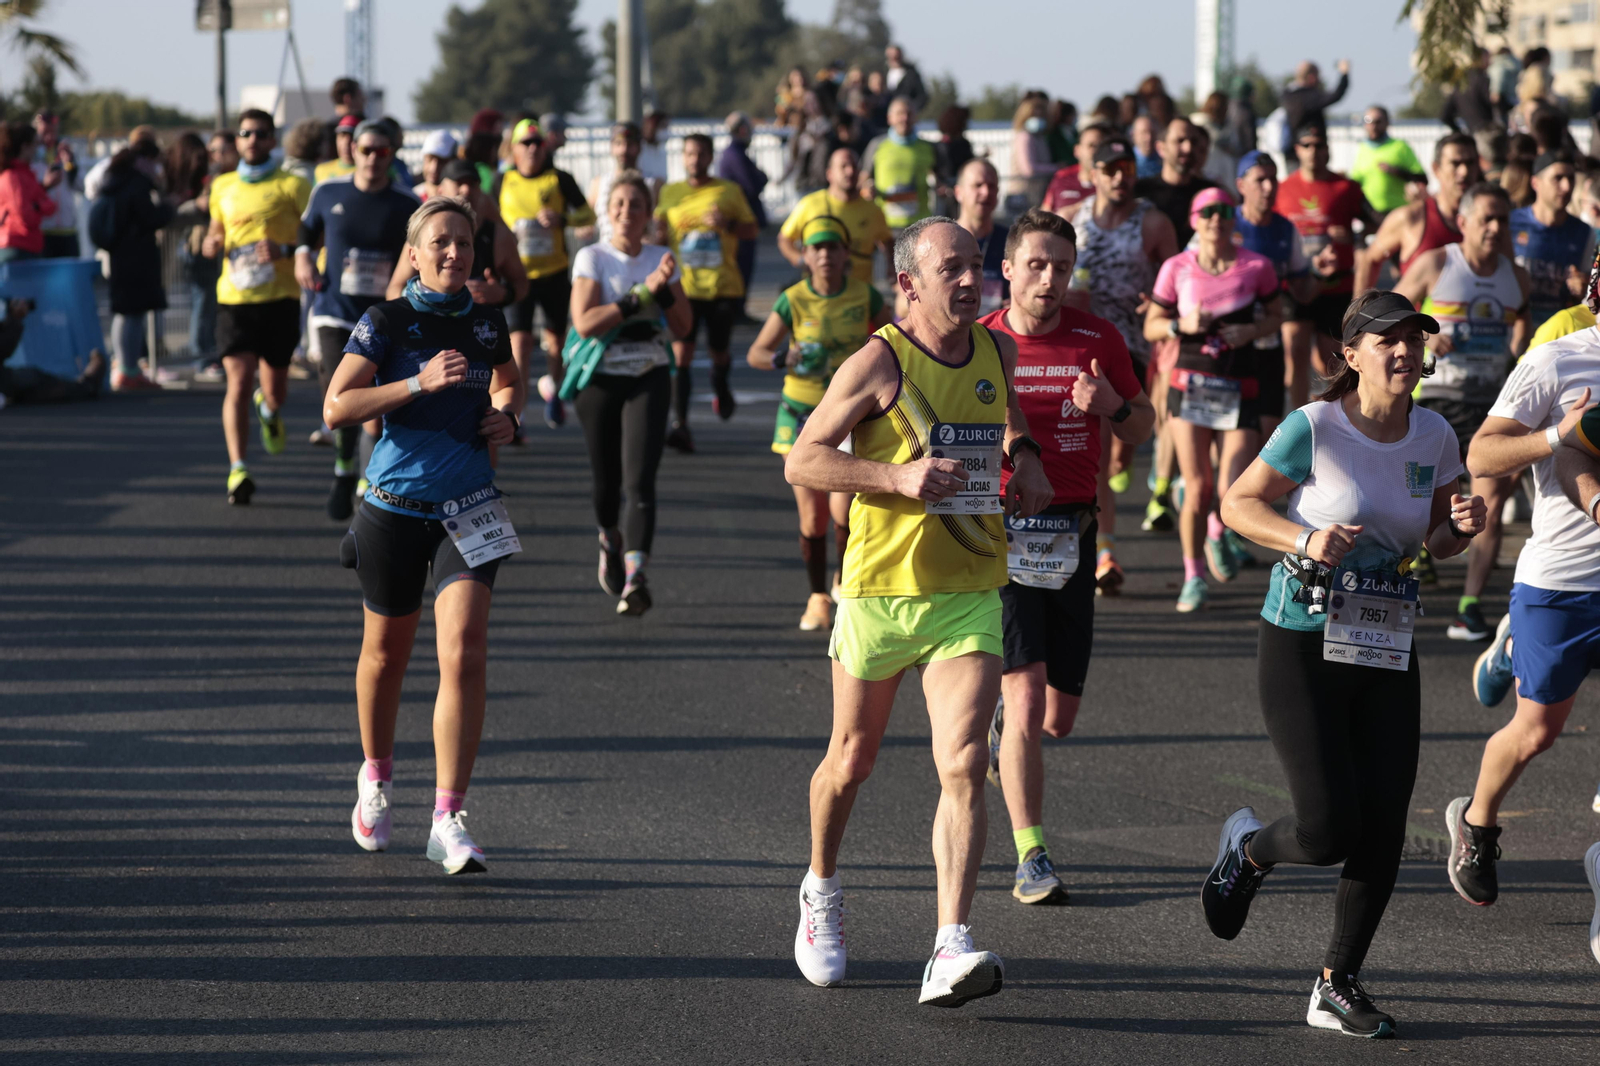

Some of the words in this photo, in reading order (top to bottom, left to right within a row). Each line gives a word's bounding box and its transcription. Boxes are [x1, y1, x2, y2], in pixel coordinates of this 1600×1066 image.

[957, 429, 1002, 441] ZURICH
[960, 457, 987, 471] 7884
[961, 480, 991, 492] LICIAS
[470, 510, 498, 529] 9121
[1027, 518, 1070, 530] ZURICH
[482, 526, 505, 542] MELY
[1027, 542, 1054, 554] 9506
[1019, 558, 1063, 570] GEOFFREY
[1361, 578, 1407, 595] ZURICH
[1360, 607, 1389, 623] 7957
[1349, 630, 1392, 645] KENZA
